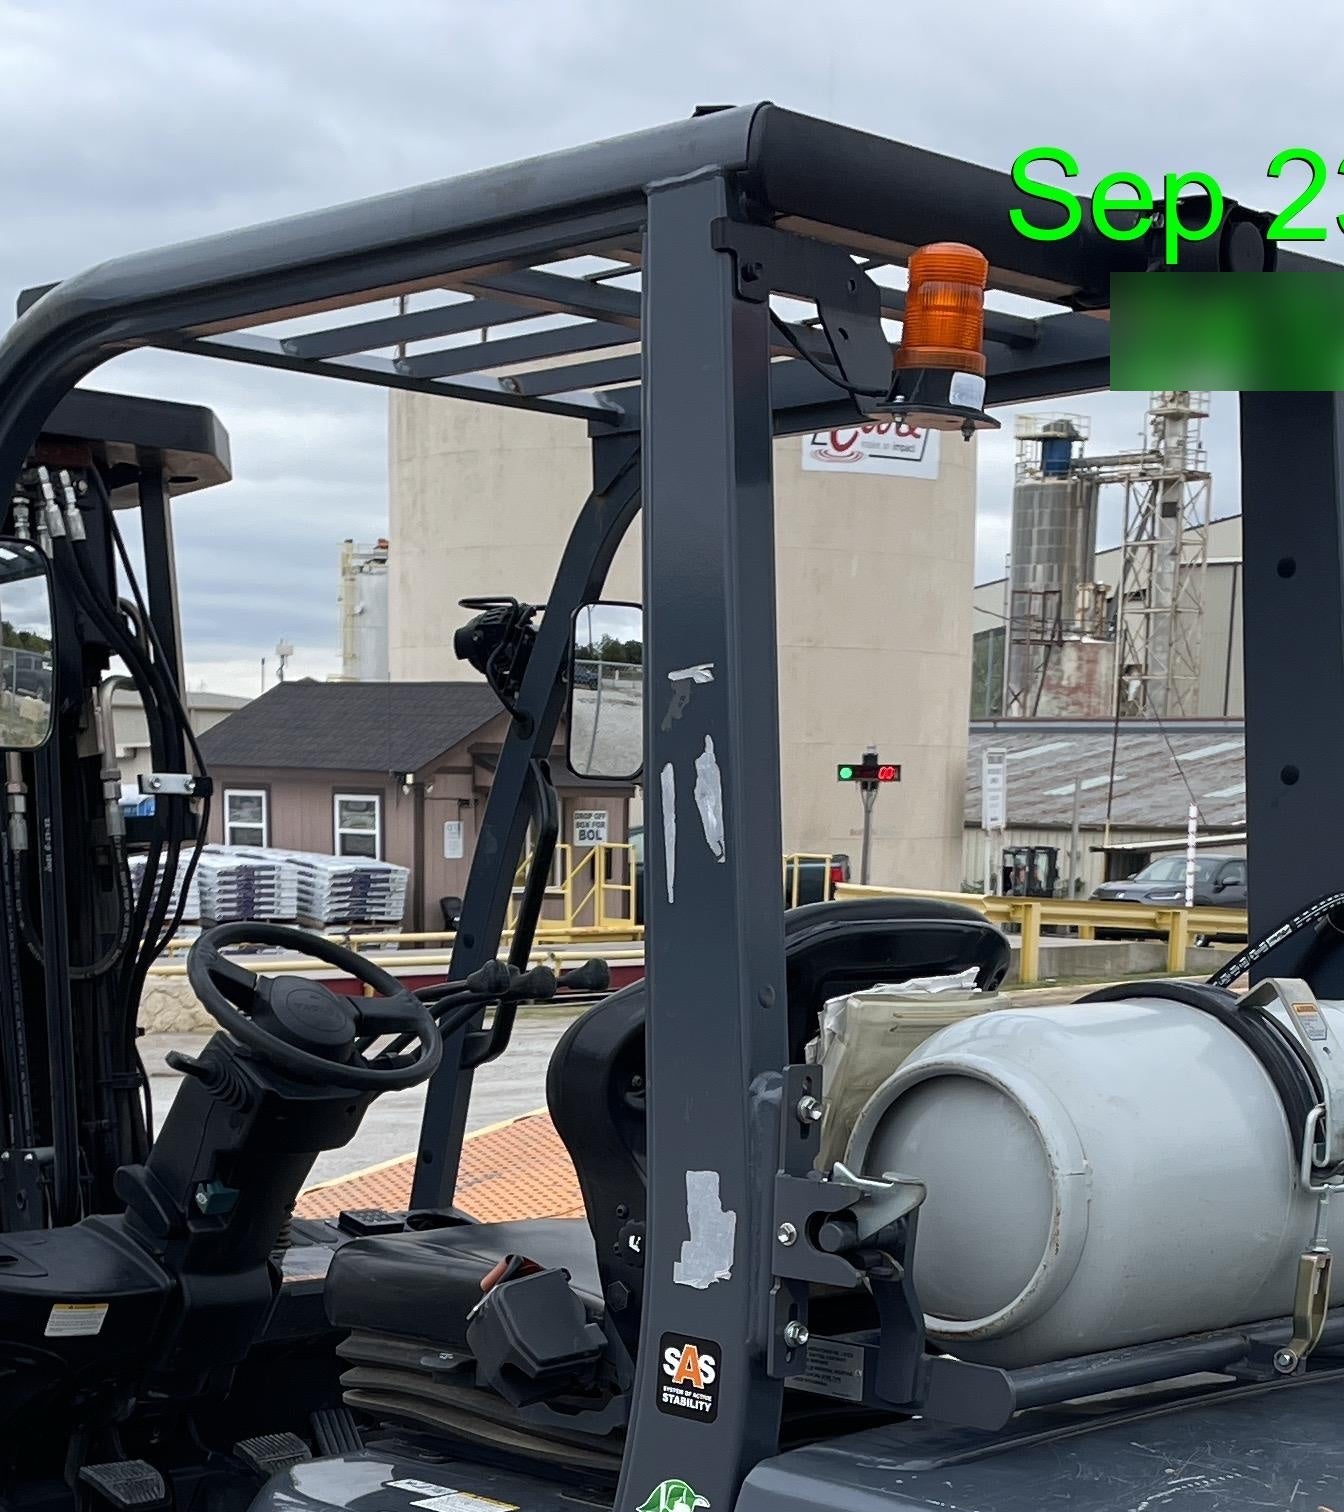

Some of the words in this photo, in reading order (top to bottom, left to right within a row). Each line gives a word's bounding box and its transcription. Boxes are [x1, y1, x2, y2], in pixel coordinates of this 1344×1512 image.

[579, 829, 602, 840] BOL
[662, 1343, 716, 1389] SAS
[662, 1392, 712, 1412] STABILITY
